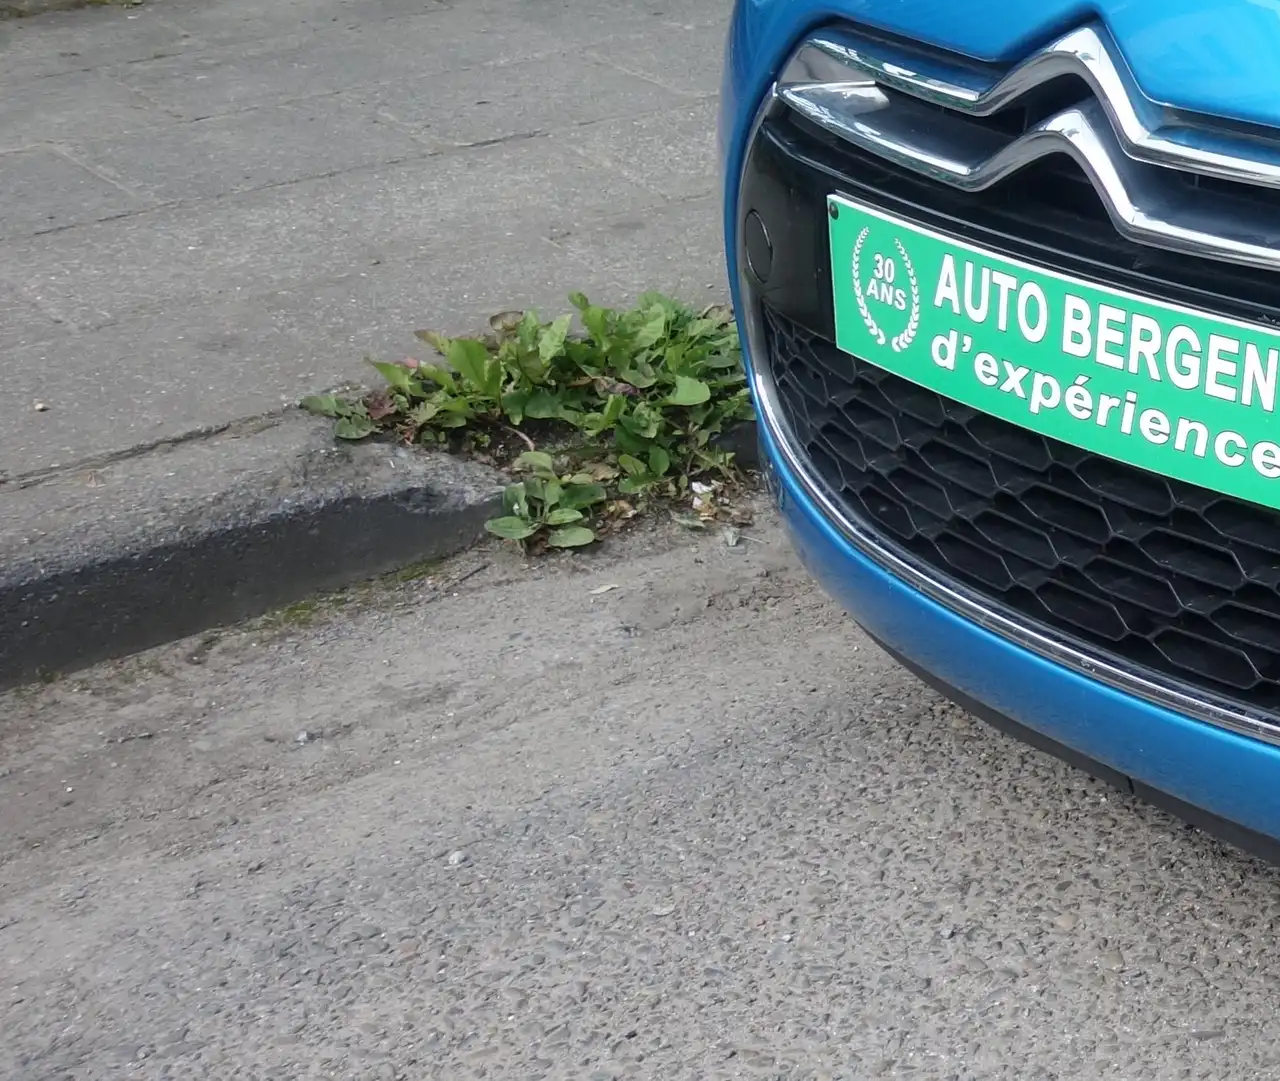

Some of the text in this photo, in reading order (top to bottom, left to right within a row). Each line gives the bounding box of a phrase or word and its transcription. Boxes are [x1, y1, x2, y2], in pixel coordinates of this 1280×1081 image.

[873, 252, 895, 283] 30
[866, 278, 907, 311] ANS
[934, 253, 1280, 413] AUTO BERGEN
